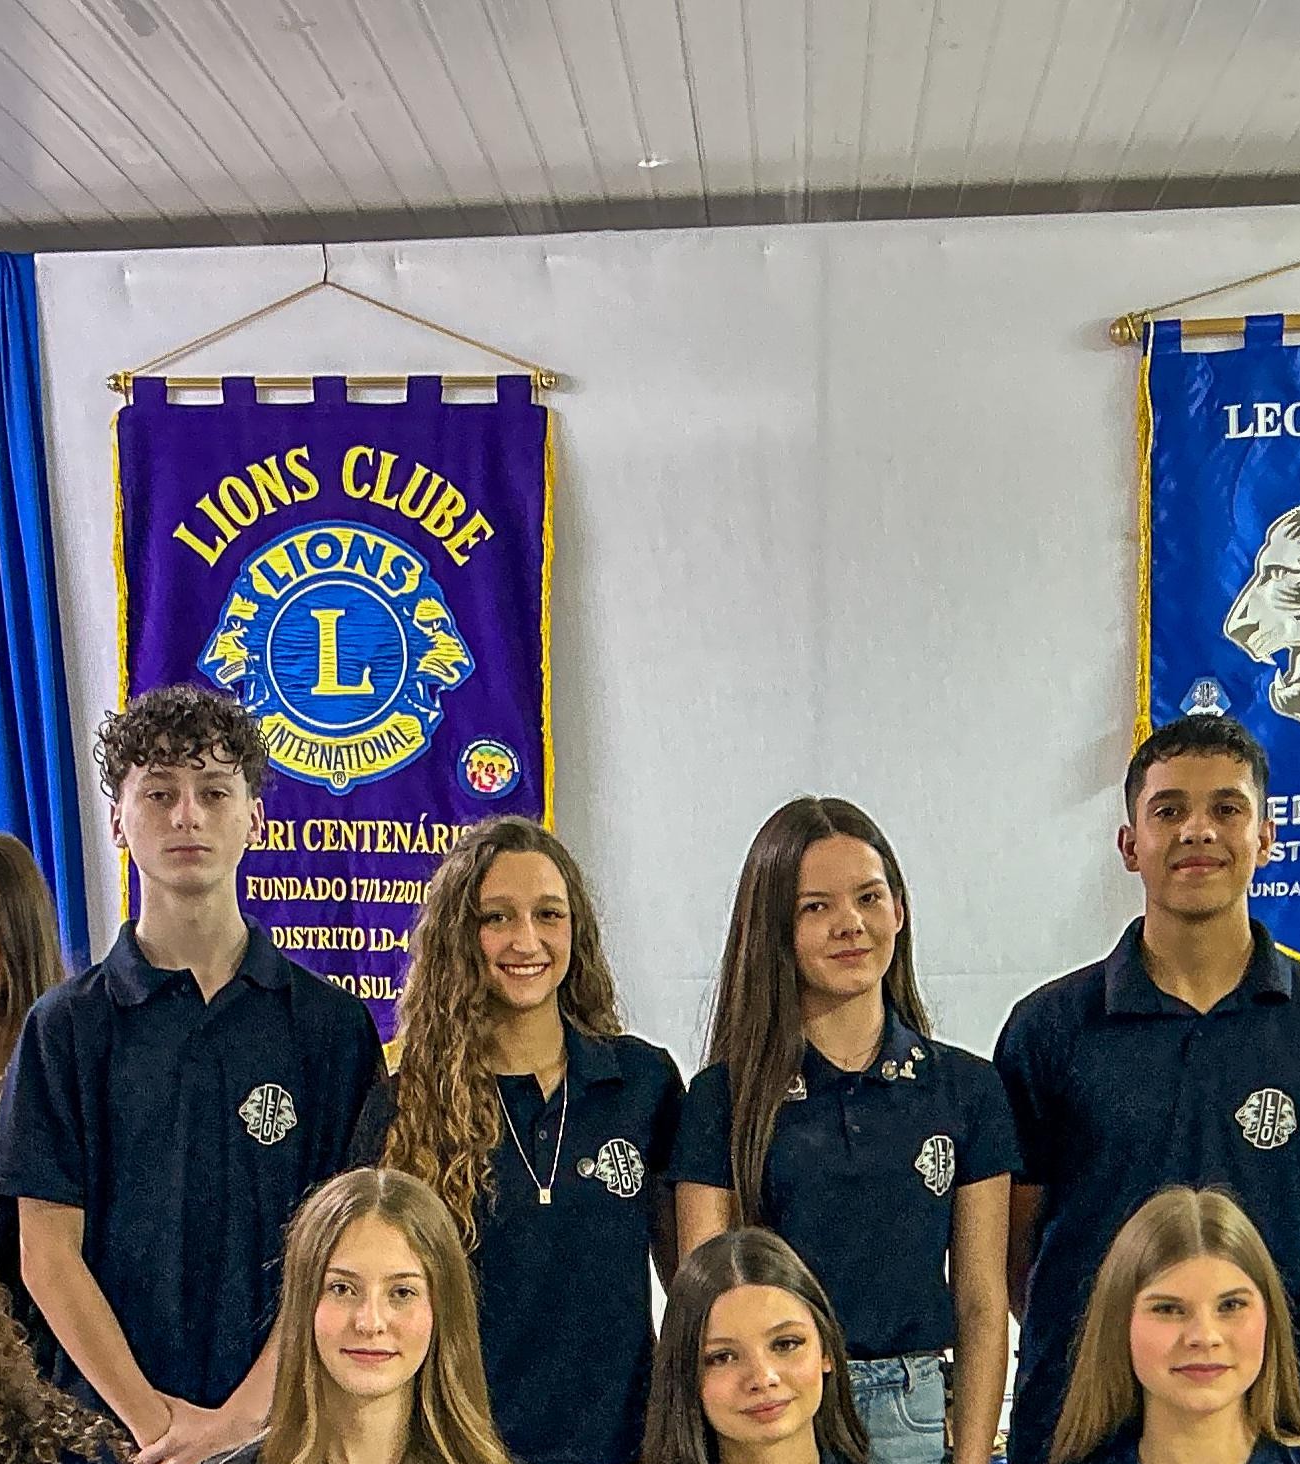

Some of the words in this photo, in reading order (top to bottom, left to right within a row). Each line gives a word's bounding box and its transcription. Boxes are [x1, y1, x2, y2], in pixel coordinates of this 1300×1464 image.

[172, 445, 321, 568] LIONS
[342, 444, 495, 566] CLUBE
[256, 532, 416, 593] LIONS
[310, 608, 375, 695] L
[267, 722, 416, 771] INTERNATIONAL
[246, 876, 347, 902] FUNDADO
[270, 926, 366, 951] DISTRITO
[263, 1088, 276, 1137] LEO
[1260, 1093, 1276, 1141] LEO
[613, 1143, 632, 1190] LEO
[936, 1138, 948, 1188] LEO
